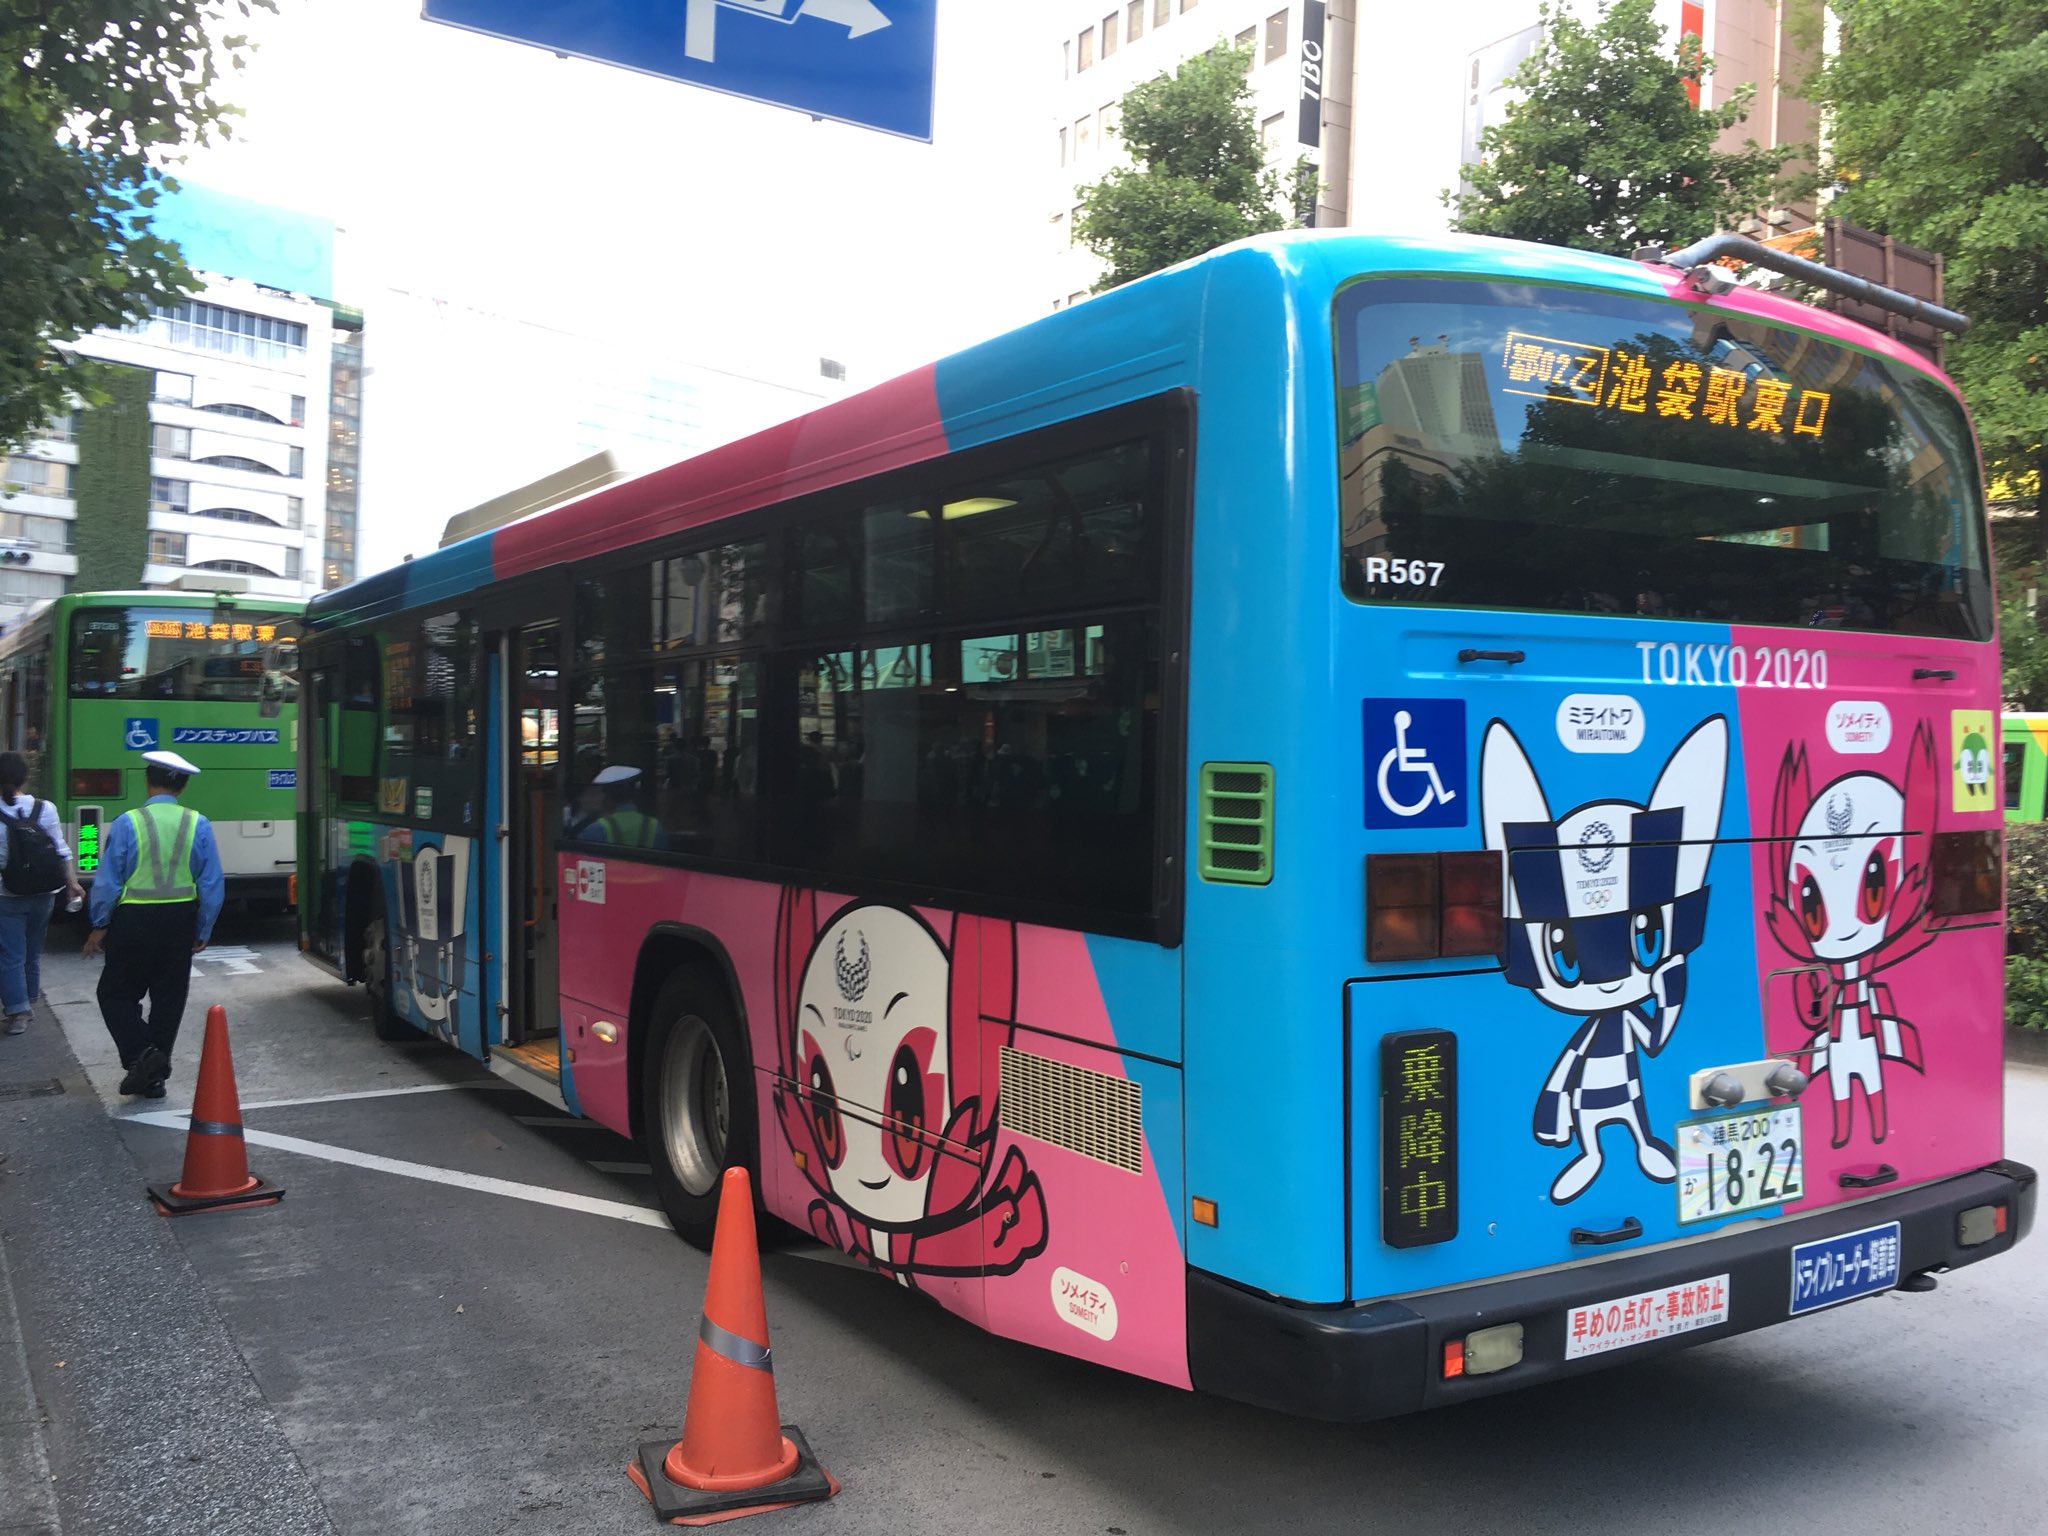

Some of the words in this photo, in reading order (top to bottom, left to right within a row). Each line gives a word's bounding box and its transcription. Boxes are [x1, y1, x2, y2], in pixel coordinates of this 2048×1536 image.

[1300, 39, 1322, 101] TBC
[1605, 350, 1831, 437] 池袋駅東口
[1366, 557, 1446, 587] R567
[185, 622, 297, 641] 池袋駅東
[1635, 641, 1747, 687] TOKYO
[1754, 646, 1829, 689] 2020
[1568, 706, 1633, 726] ミライトワ
[173, 729, 279, 742] ノンステップバス
[1401, 1043, 1447, 1228] 乗降中
[1060, 1278, 1107, 1315] ソメイティ
[1069, 1301, 1099, 1326] SOMEITY
[1572, 1279, 1725, 1343] 早めの点灯で事故防止
